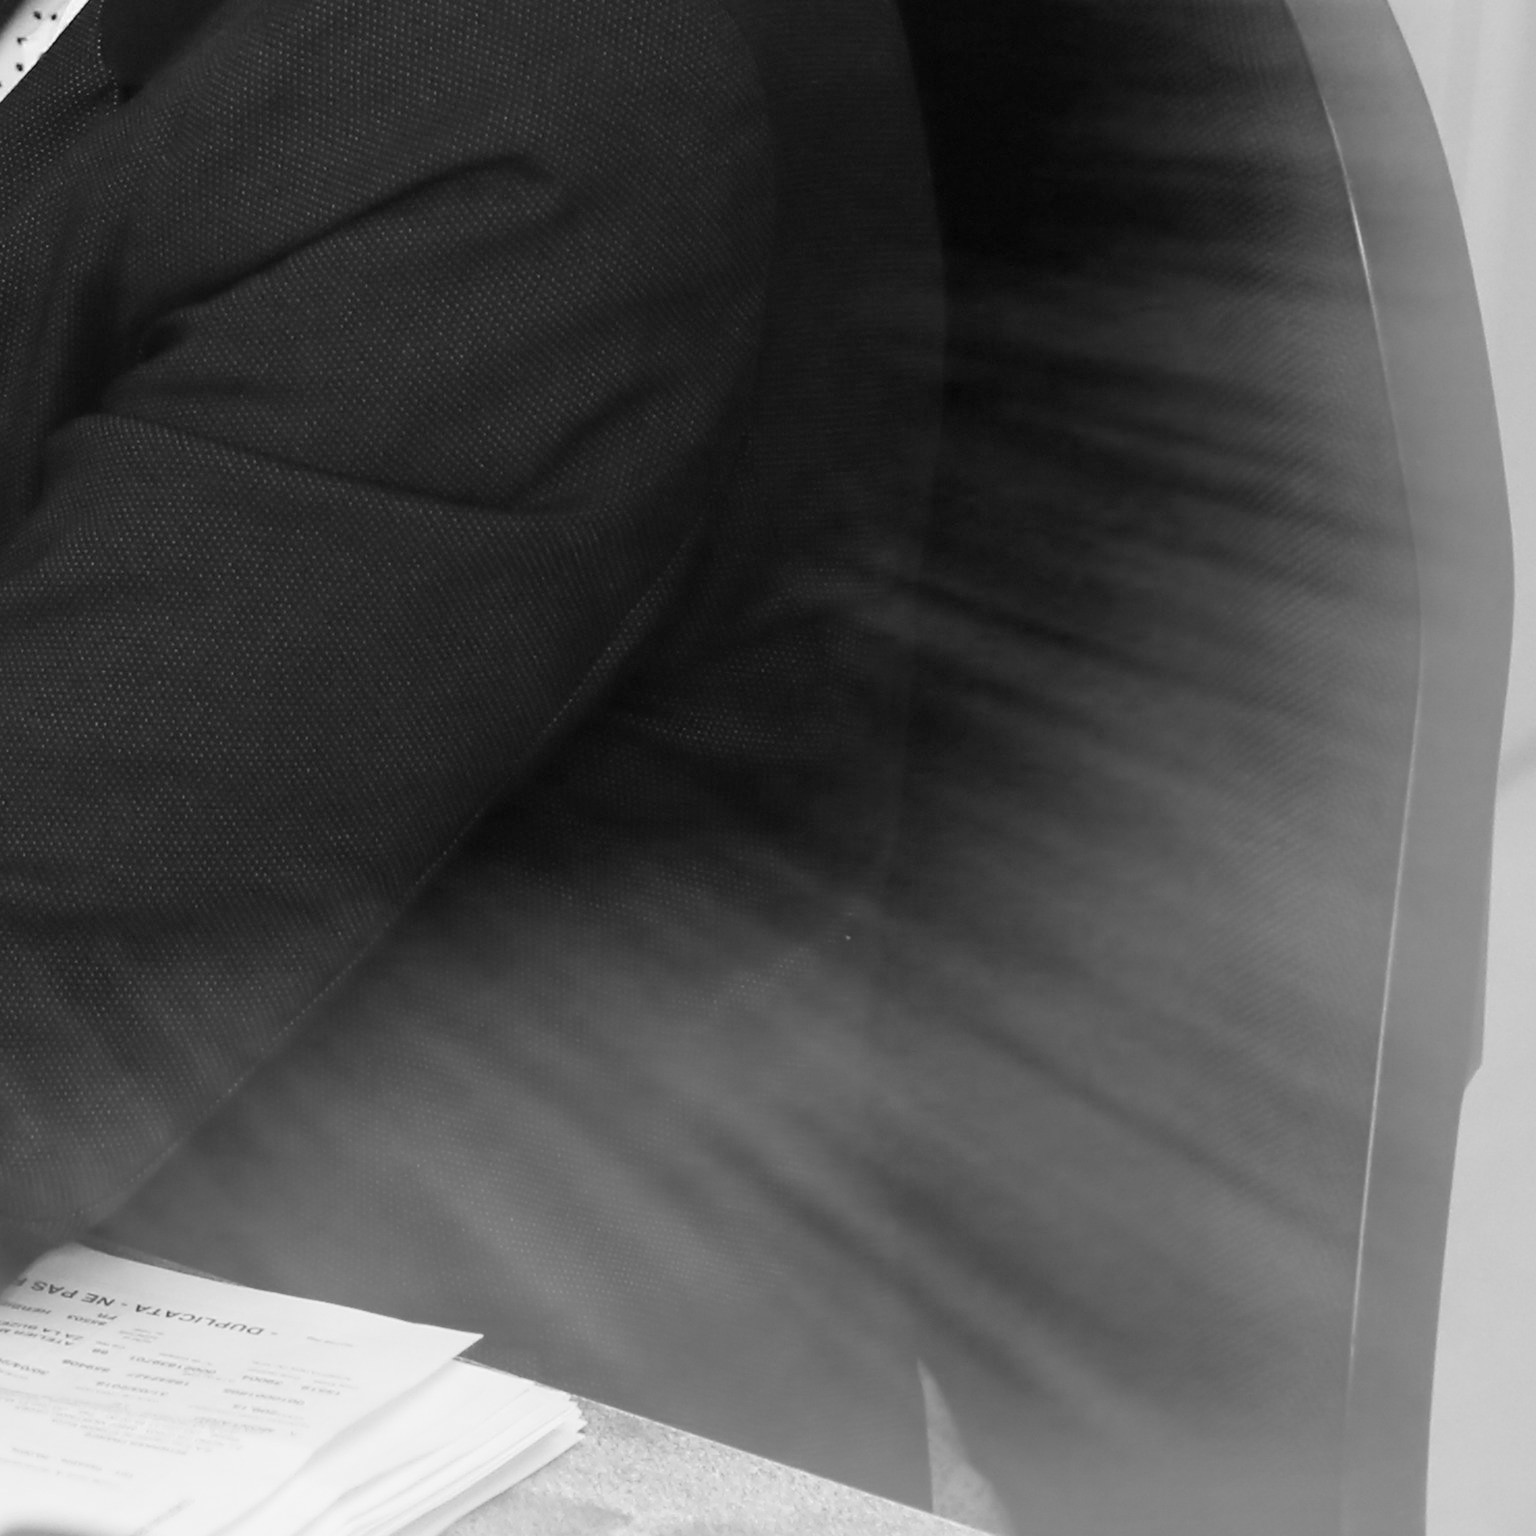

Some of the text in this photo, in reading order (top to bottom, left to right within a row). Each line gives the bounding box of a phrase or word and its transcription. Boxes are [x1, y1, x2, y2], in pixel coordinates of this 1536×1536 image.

[30, 1280, 79, 1300] PAS
[81, 1292, 116, 1308] NE
[134, 1303, 265, 1336] DUPLICATA
